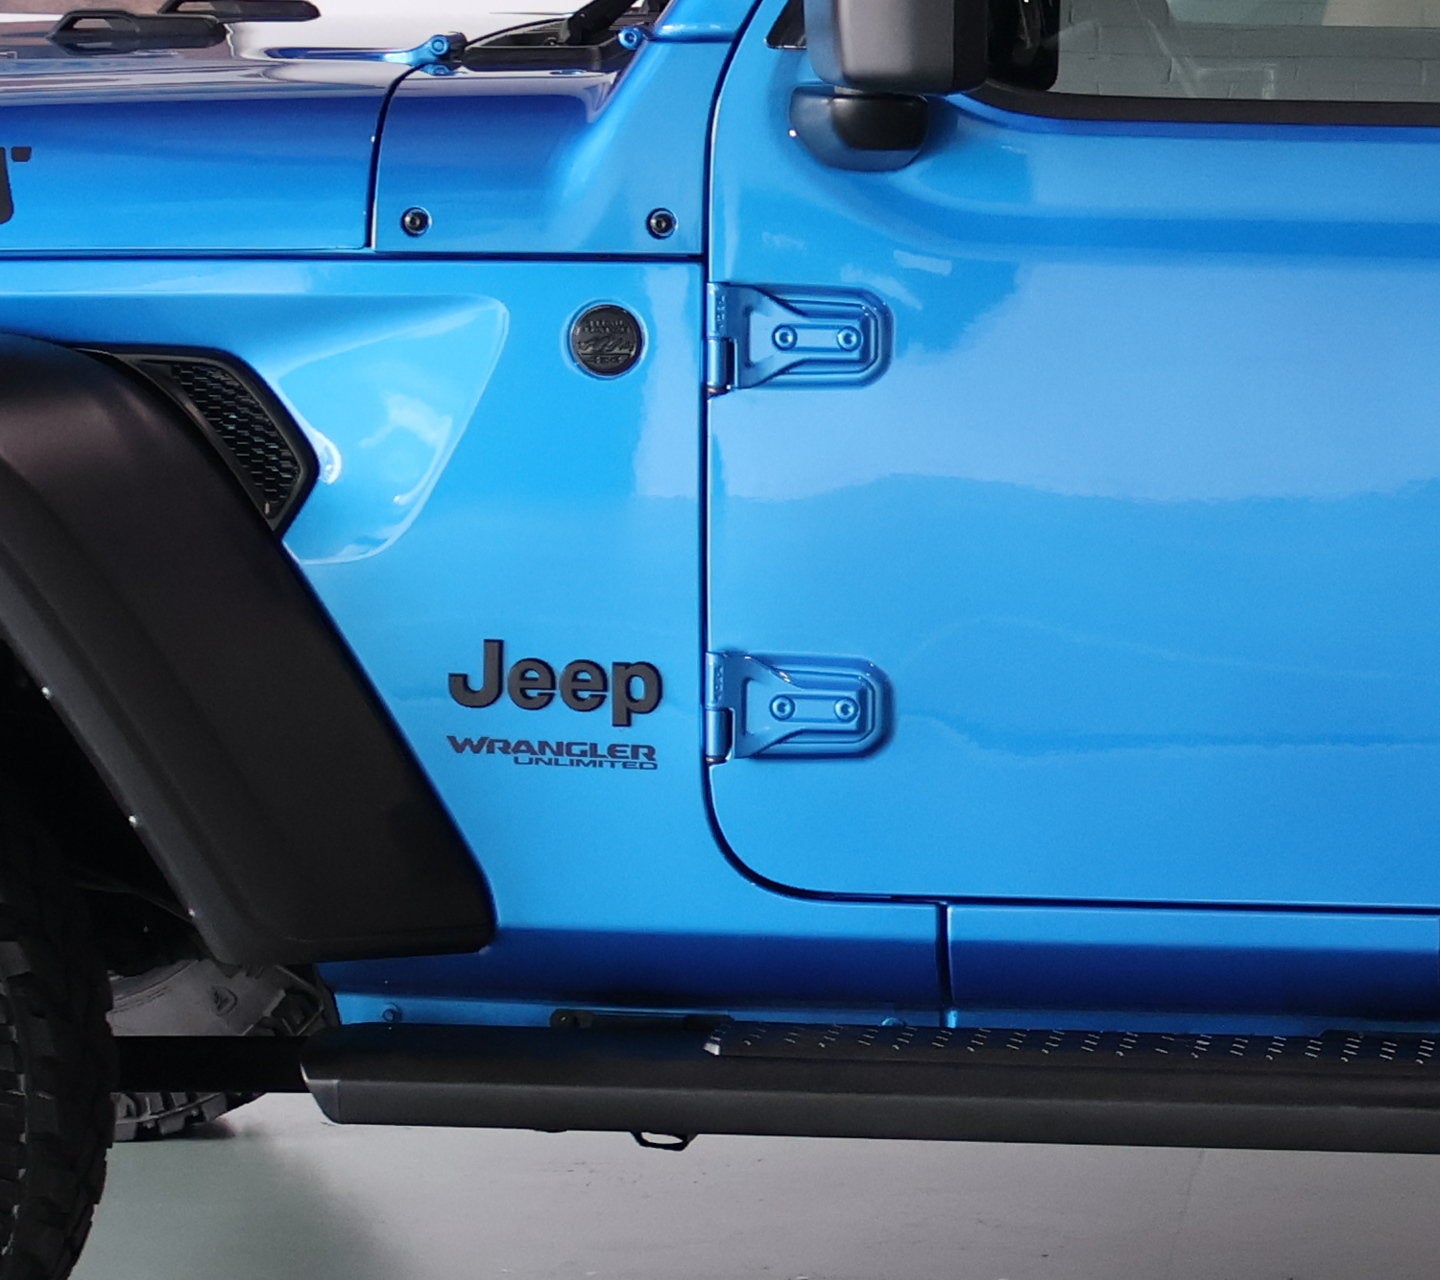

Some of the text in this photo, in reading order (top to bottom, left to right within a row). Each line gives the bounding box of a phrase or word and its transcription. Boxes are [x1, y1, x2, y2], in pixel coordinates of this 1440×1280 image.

[447, 638, 664, 728] Jeep
[446, 734, 657, 762] WRANGLER
[512, 755, 658, 770] UNLIMITED
